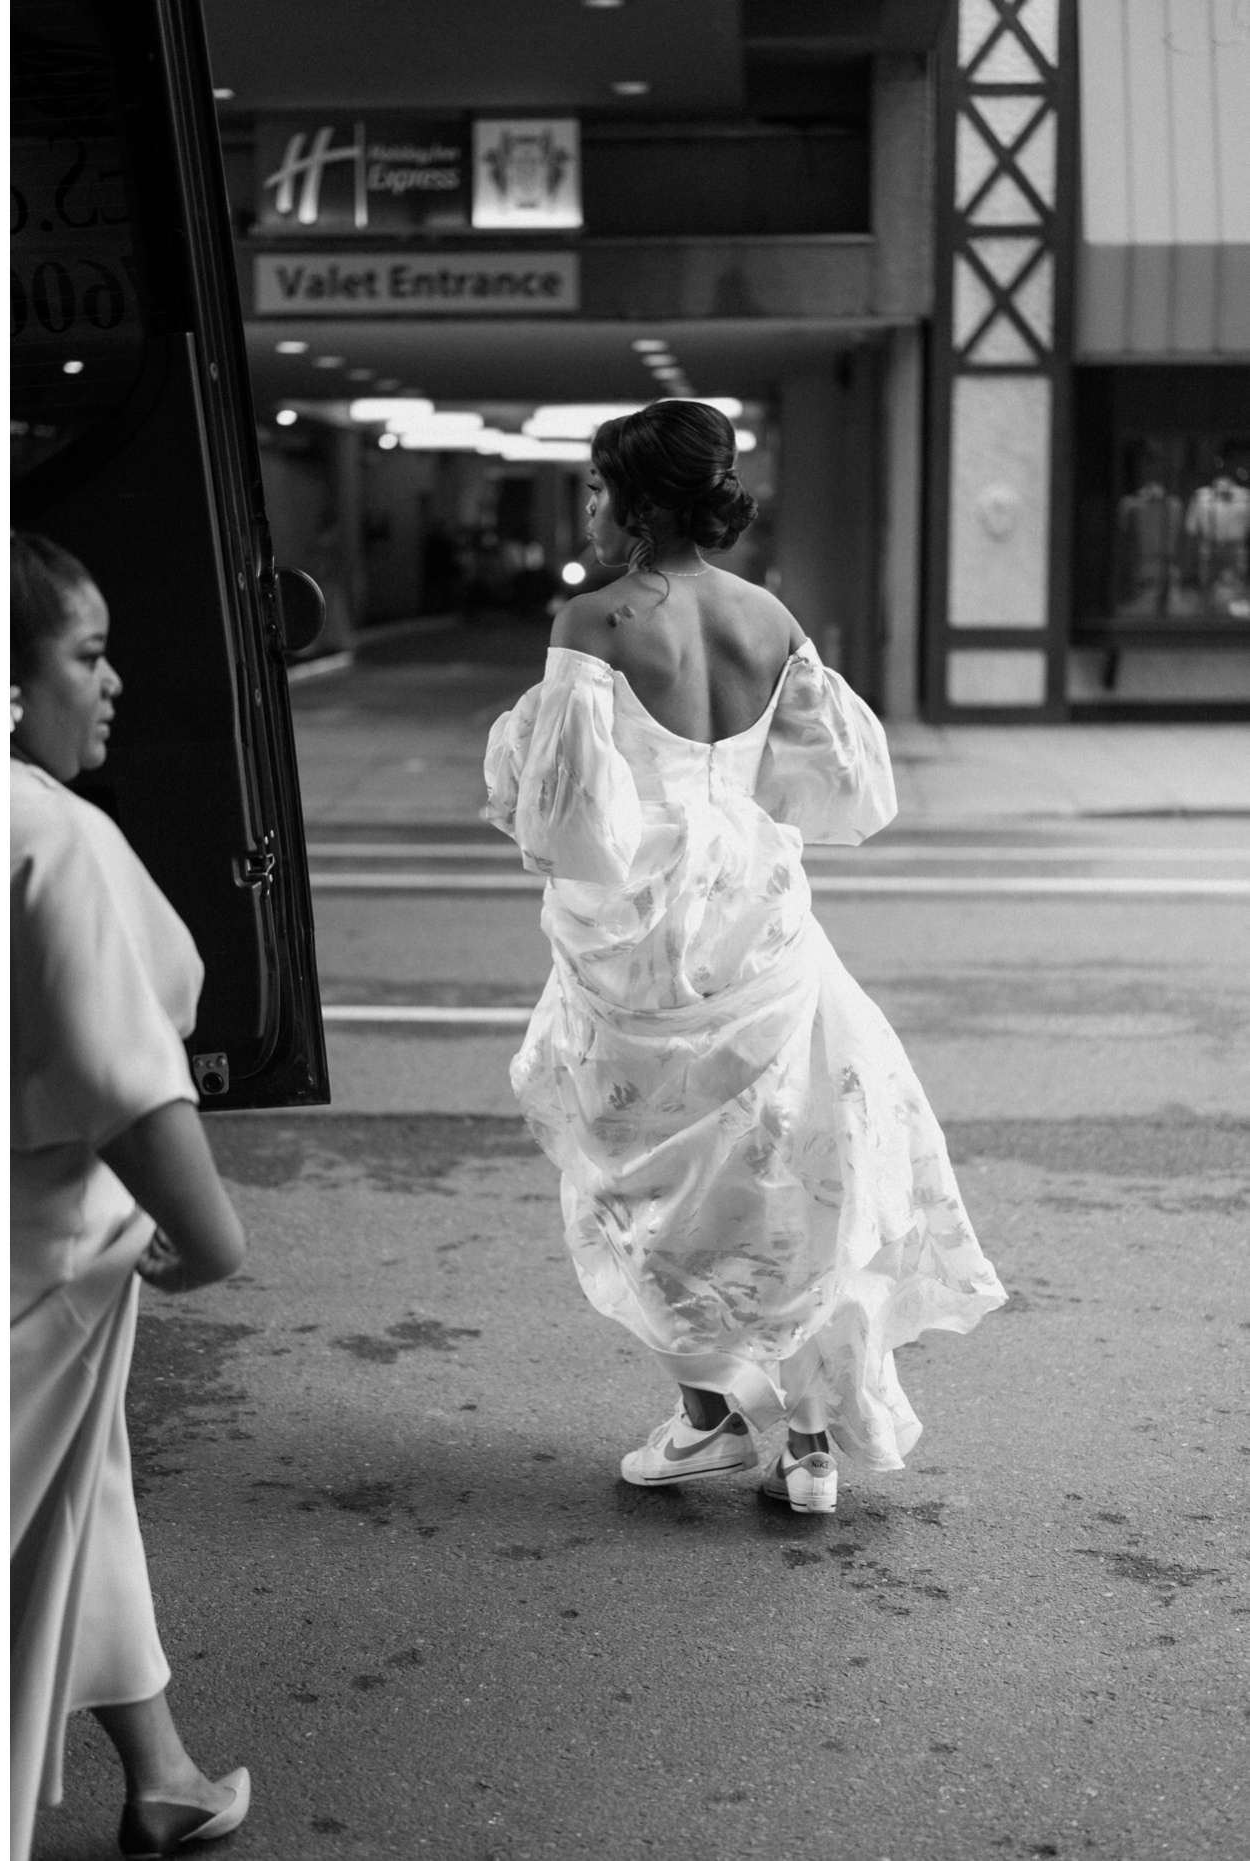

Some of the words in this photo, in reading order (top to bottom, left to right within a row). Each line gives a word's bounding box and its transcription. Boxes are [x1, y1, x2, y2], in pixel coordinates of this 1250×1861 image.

[276, 265, 377, 299] Valet
[388, 265, 562, 299] Entrance
[811, 1460, 829, 1469] NIKE
